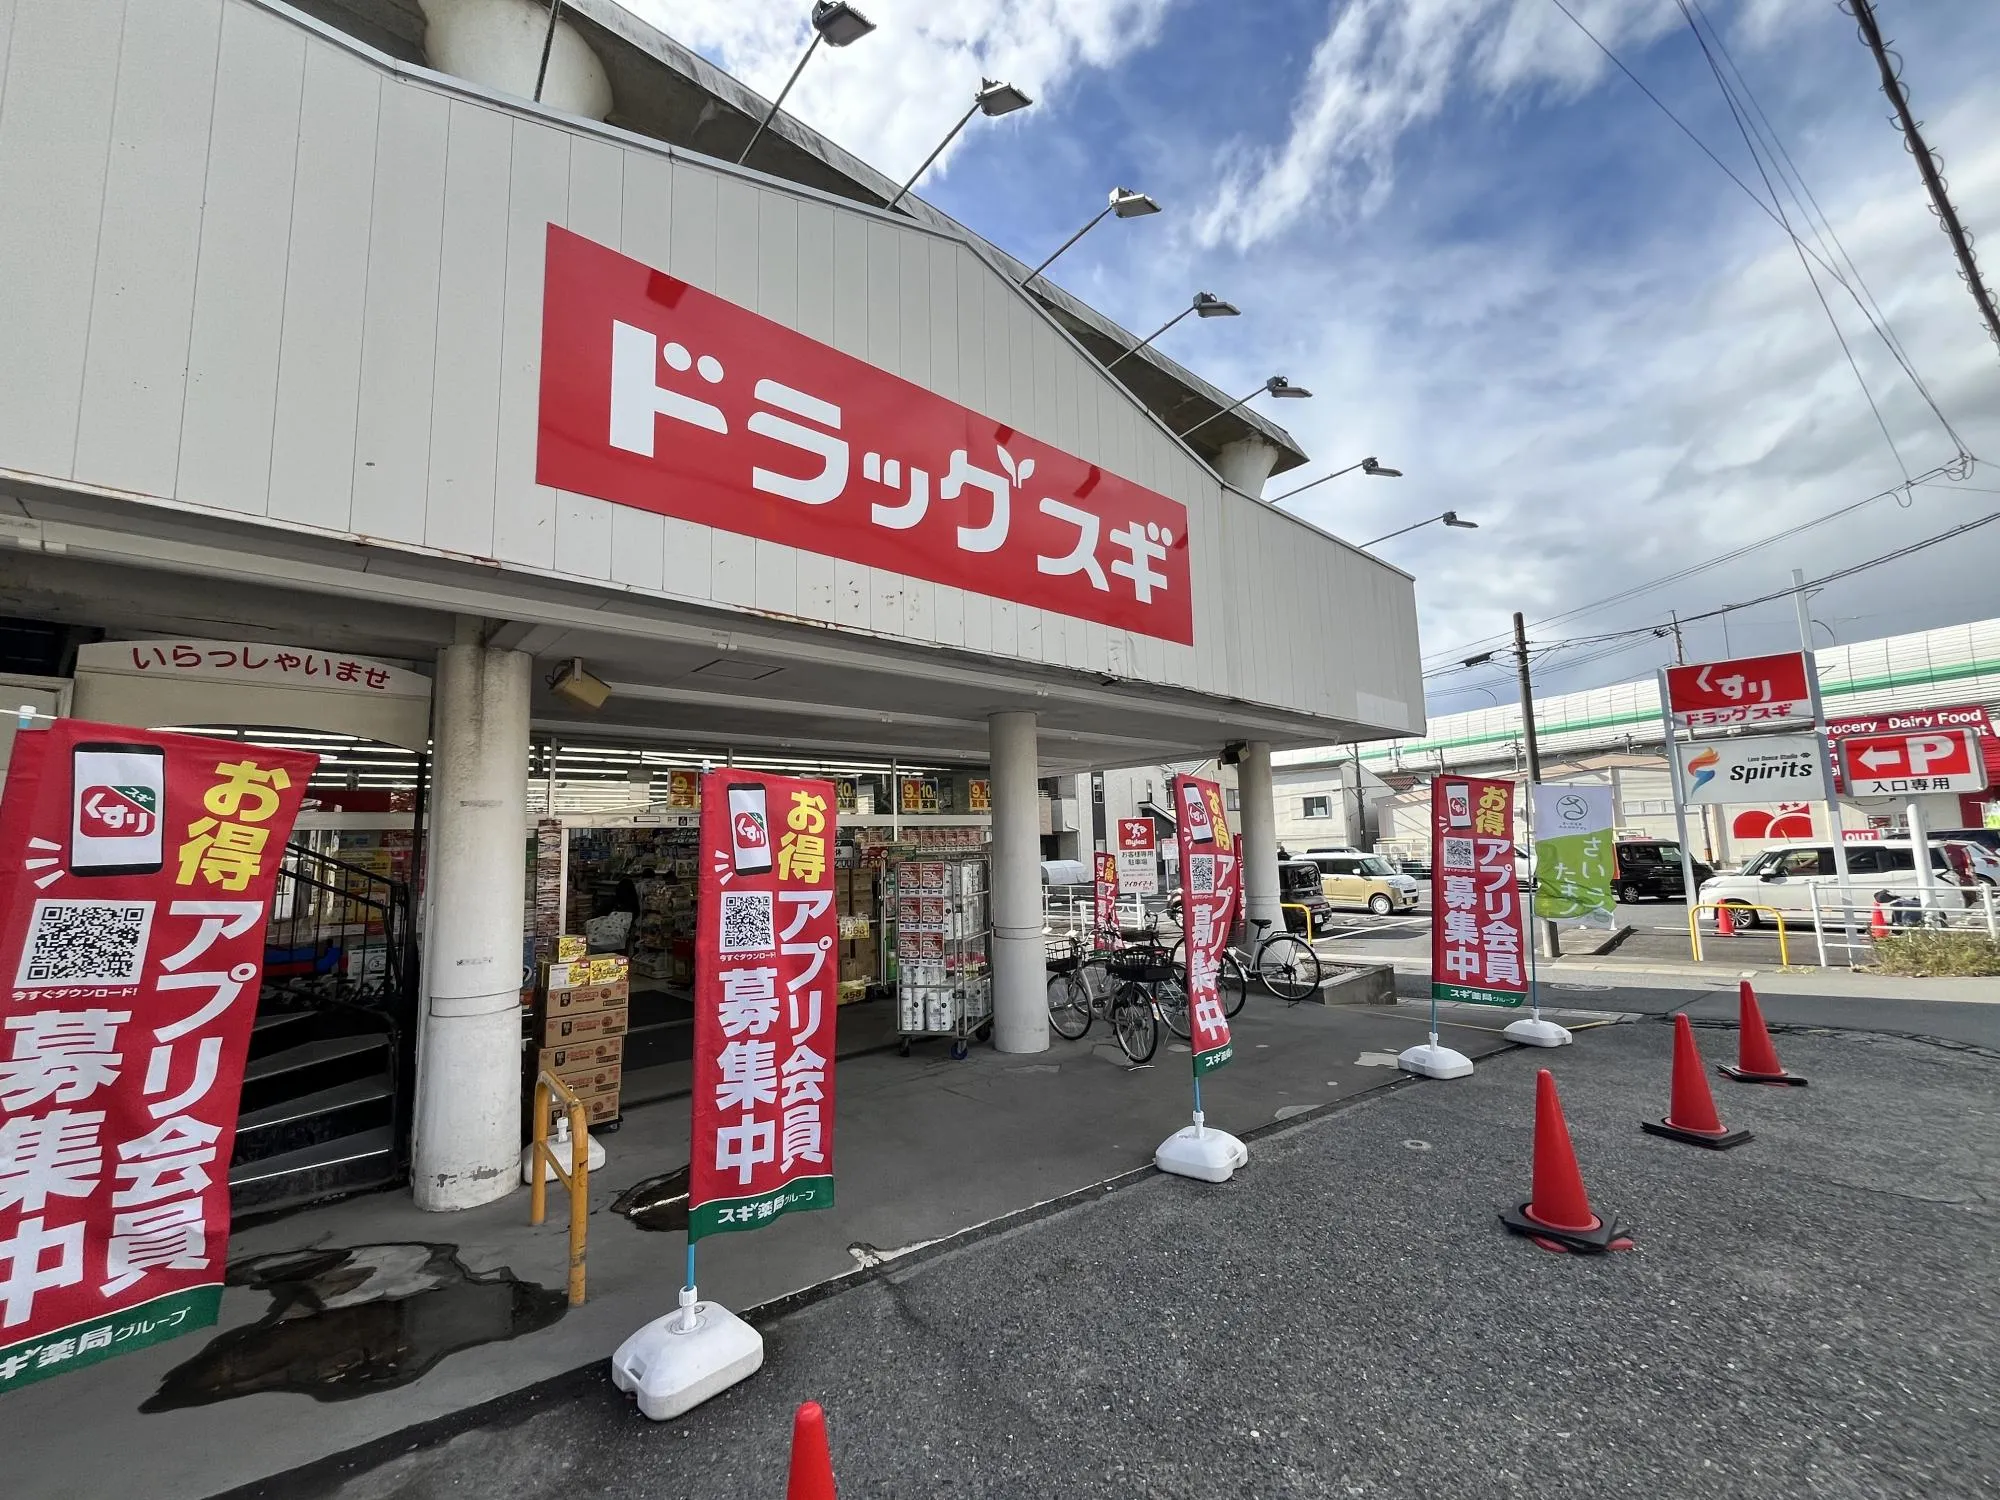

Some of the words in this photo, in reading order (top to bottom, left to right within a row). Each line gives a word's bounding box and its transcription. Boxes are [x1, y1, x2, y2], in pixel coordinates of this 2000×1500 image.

[132, 646, 391, 690] いらっしゃいませ
[1696, 666, 1772, 702] くすり
[1827, 720, 1877, 735] rocery
[1888, 715, 1933, 729] Dairy
[1937, 709, 1982, 724] Food
[1730, 762, 1813, 784] Spirits
[1906, 735, 1955, 775] P
[1872, 777, 1950, 793] 入口専用
[84, 794, 148, 833] くすり
[176, 760, 292, 892] お得
[1475, 786, 1508, 836] お得
[778, 790, 828, 884] お得
[1845, 832, 1874, 841] OUT
[1443, 875, 1480, 980] 募集中
[1476, 839, 1522, 985] アプリ会員
[11, 986, 137, 1002] 今すぐダウンロード!
[778, 890, 833, 1174] アプリ会員
[99, 900, 263, 1298] アプリ会員
[716, 967, 780, 1185] 募集中
[0, 1009, 132, 1328] 募集中
